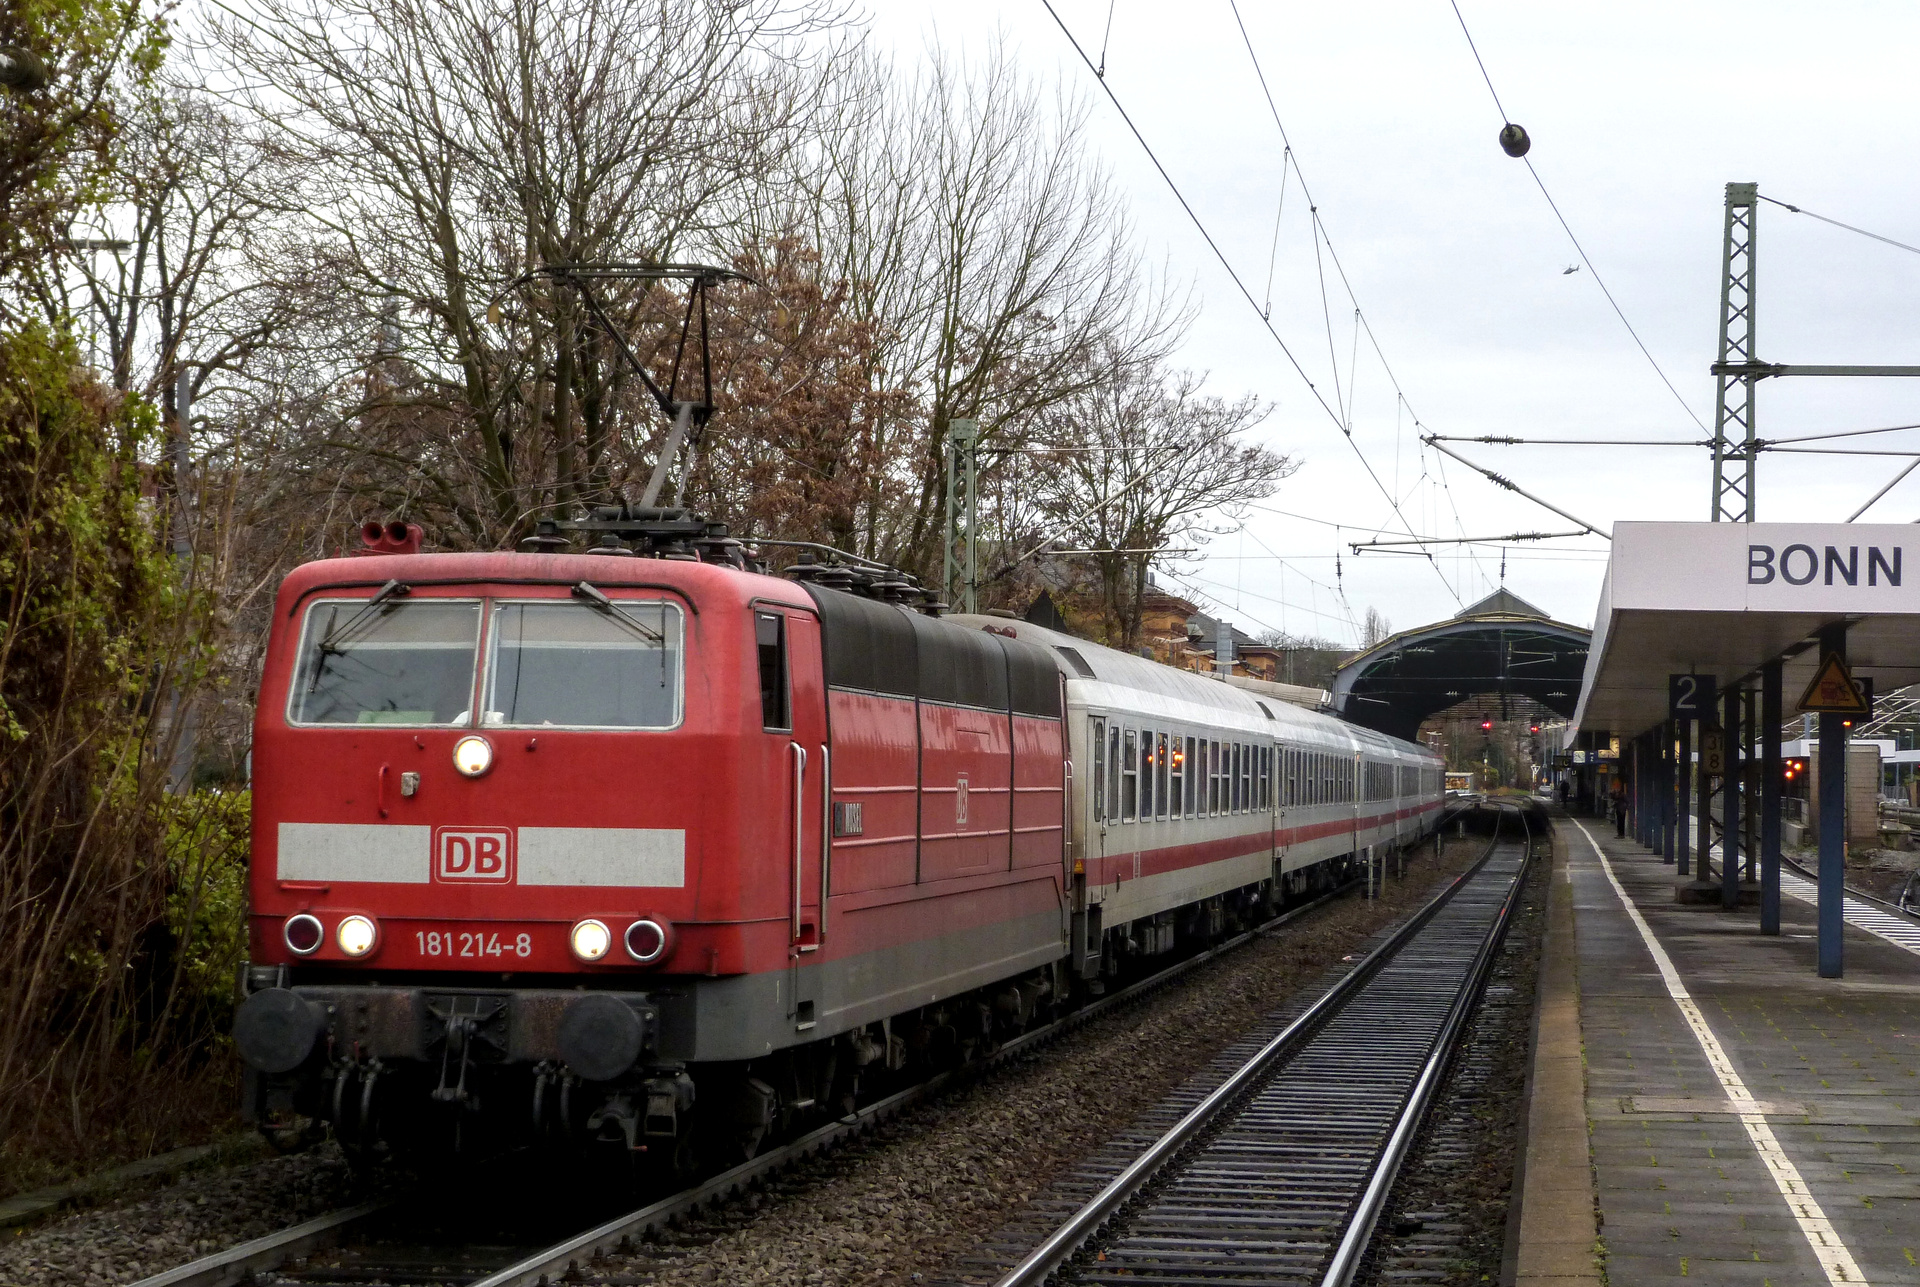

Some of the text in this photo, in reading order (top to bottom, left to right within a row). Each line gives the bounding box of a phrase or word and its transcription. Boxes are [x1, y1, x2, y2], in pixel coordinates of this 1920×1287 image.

[1748, 543, 1902, 587] BONN
[1676, 675, 1697, 709] 2
[1709, 753, 1719, 769] 8
[445, 835, 503, 874] DB
[416, 931, 531, 957] 181 214-8
